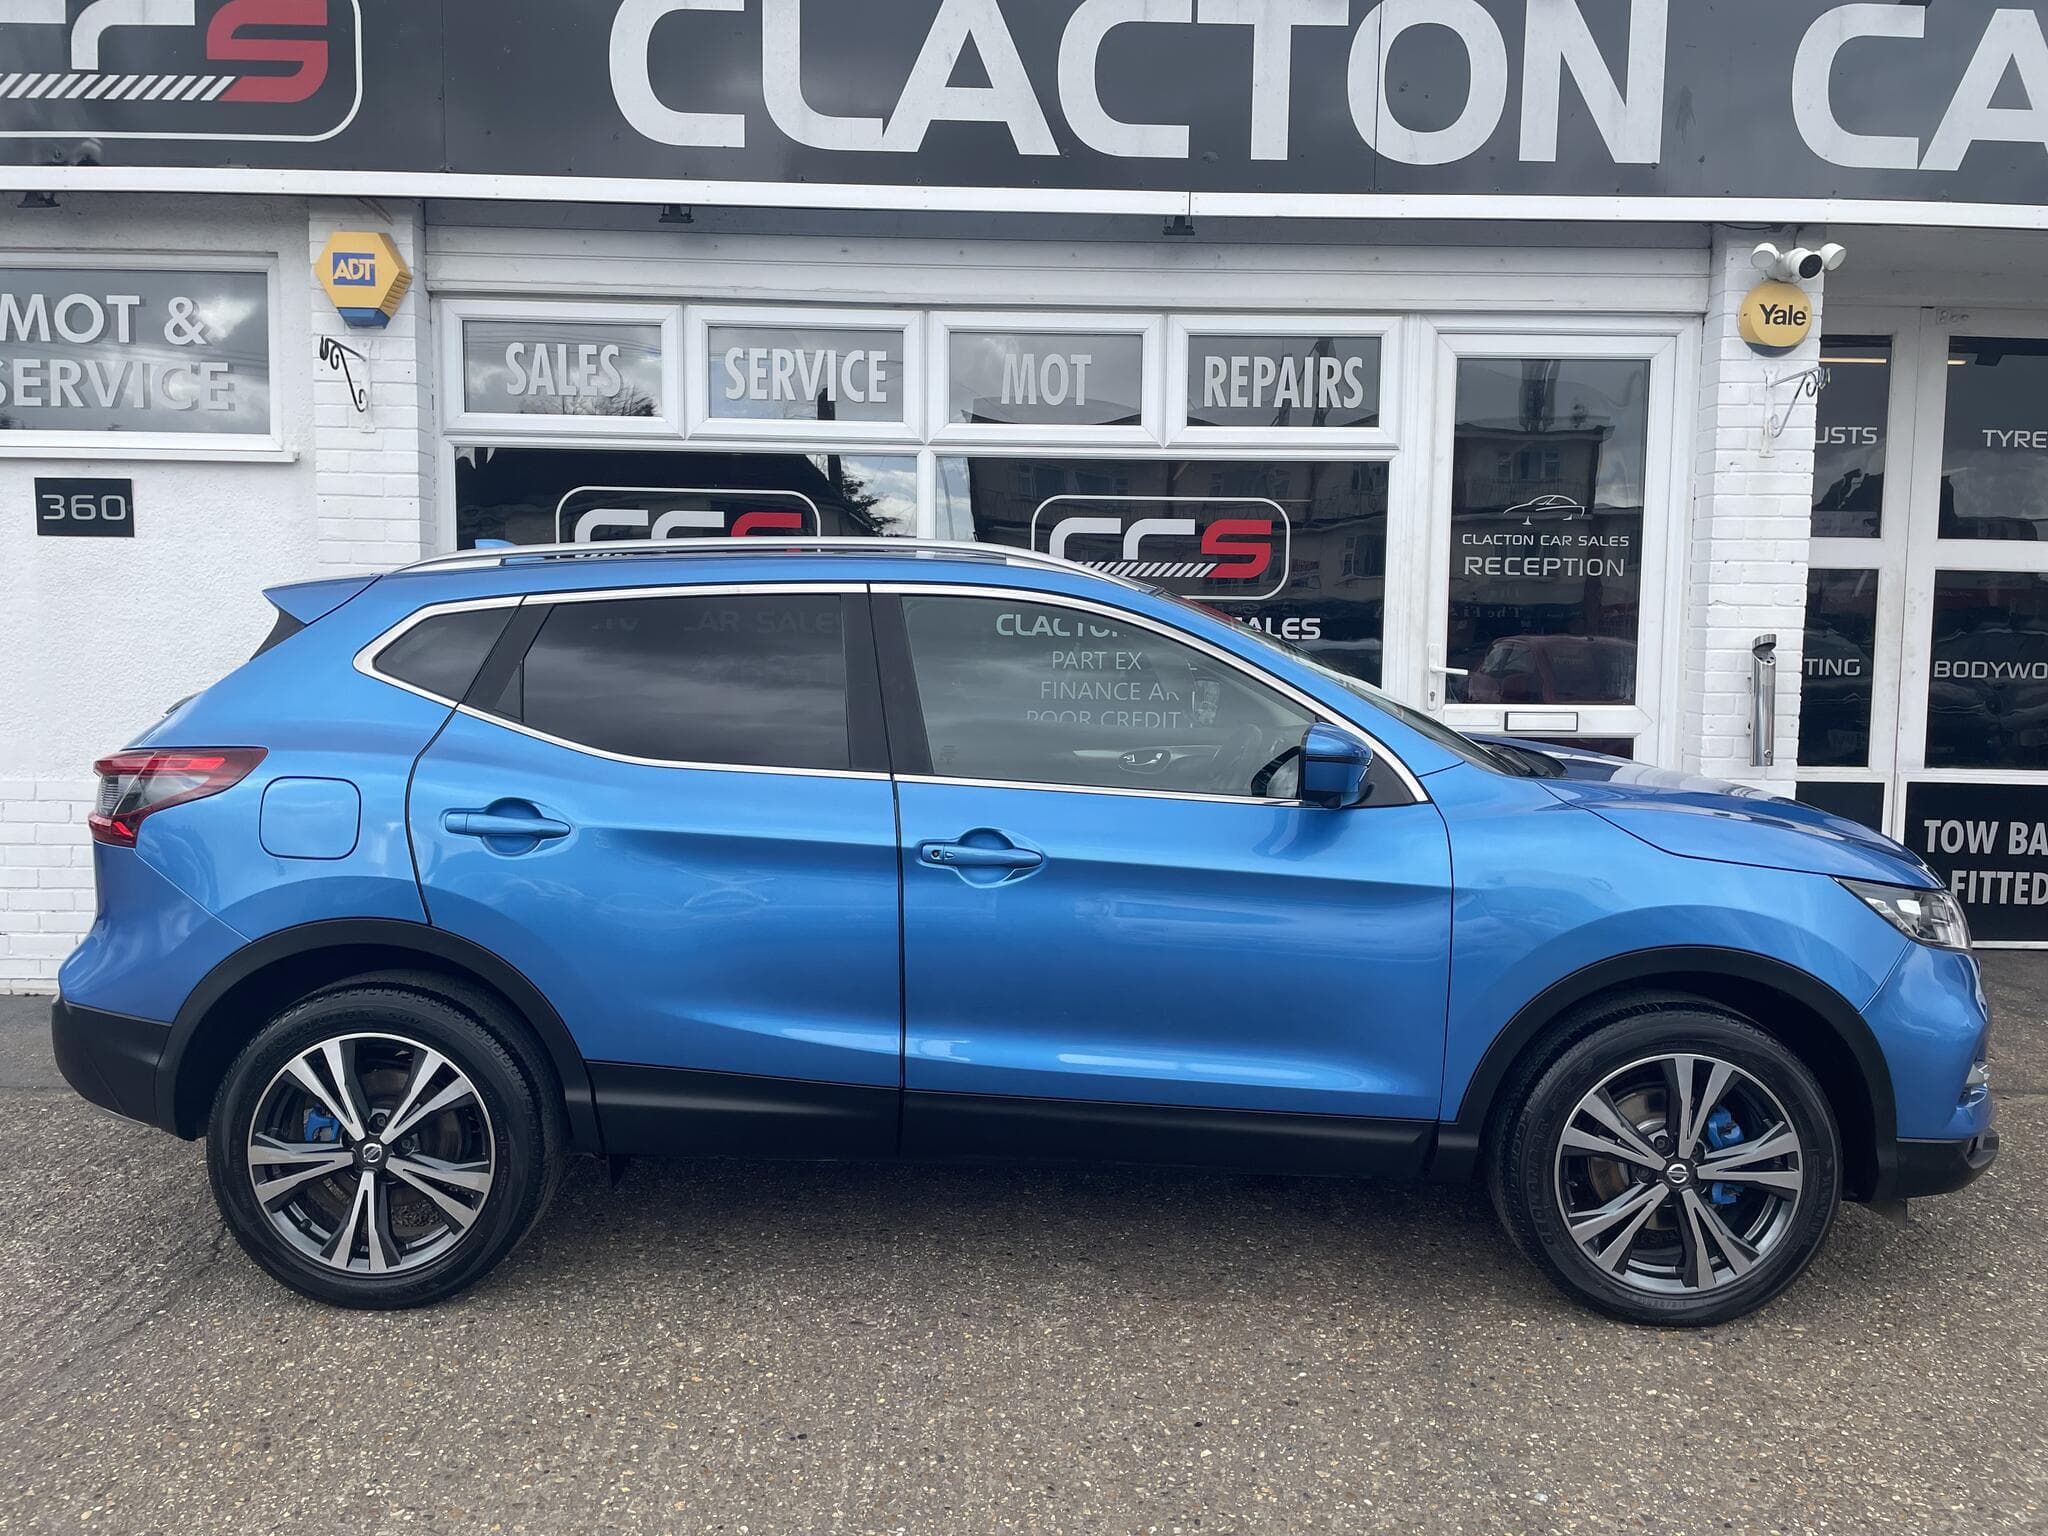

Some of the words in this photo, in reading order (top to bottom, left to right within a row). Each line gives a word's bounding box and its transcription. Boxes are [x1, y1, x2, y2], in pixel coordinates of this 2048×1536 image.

[0, 0, 328, 103] CS
[609, 0, 1669, 166] CLACTON
[1792, 3, 2048, 171] CA
[333, 257, 376, 283] ADT
[0, 293, 141, 344] MOT
[163, 296, 209, 345] &
[1758, 303, 1808, 326] Yale
[505, 342, 622, 398] SALES
[724, 347, 887, 403] SERVICE
[1000, 353, 1092, 406] MOT
[1204, 356, 1364, 409] REPAIRS
[0, 358, 230, 411] ERVICE
[1982, 429, 2047, 449] TYRE
[42, 493, 127, 521] 360
[1462, 534, 1534, 546] CLACTON
[1540, 535, 1572, 546] CAR
[1578, 536, 1629, 547] SALES
[1464, 556, 1625, 577] RECEPTION
[757, 610, 841, 633] SALE
[1233, 616, 1320, 640] ALES
[1052, 650, 1107, 670] PART
[1115, 651, 1143, 671] EX
[1804, 658, 1861, 676] TING
[1934, 660, 2048, 680] BODYWO
[1041, 682, 1141, 701] FINANCE
[1101, 711, 1182, 728] CREDIT
[1923, 819, 1999, 854] TOW
[2008, 821, 2048, 856] BA
[1951, 869, 2048, 906] FITTED
